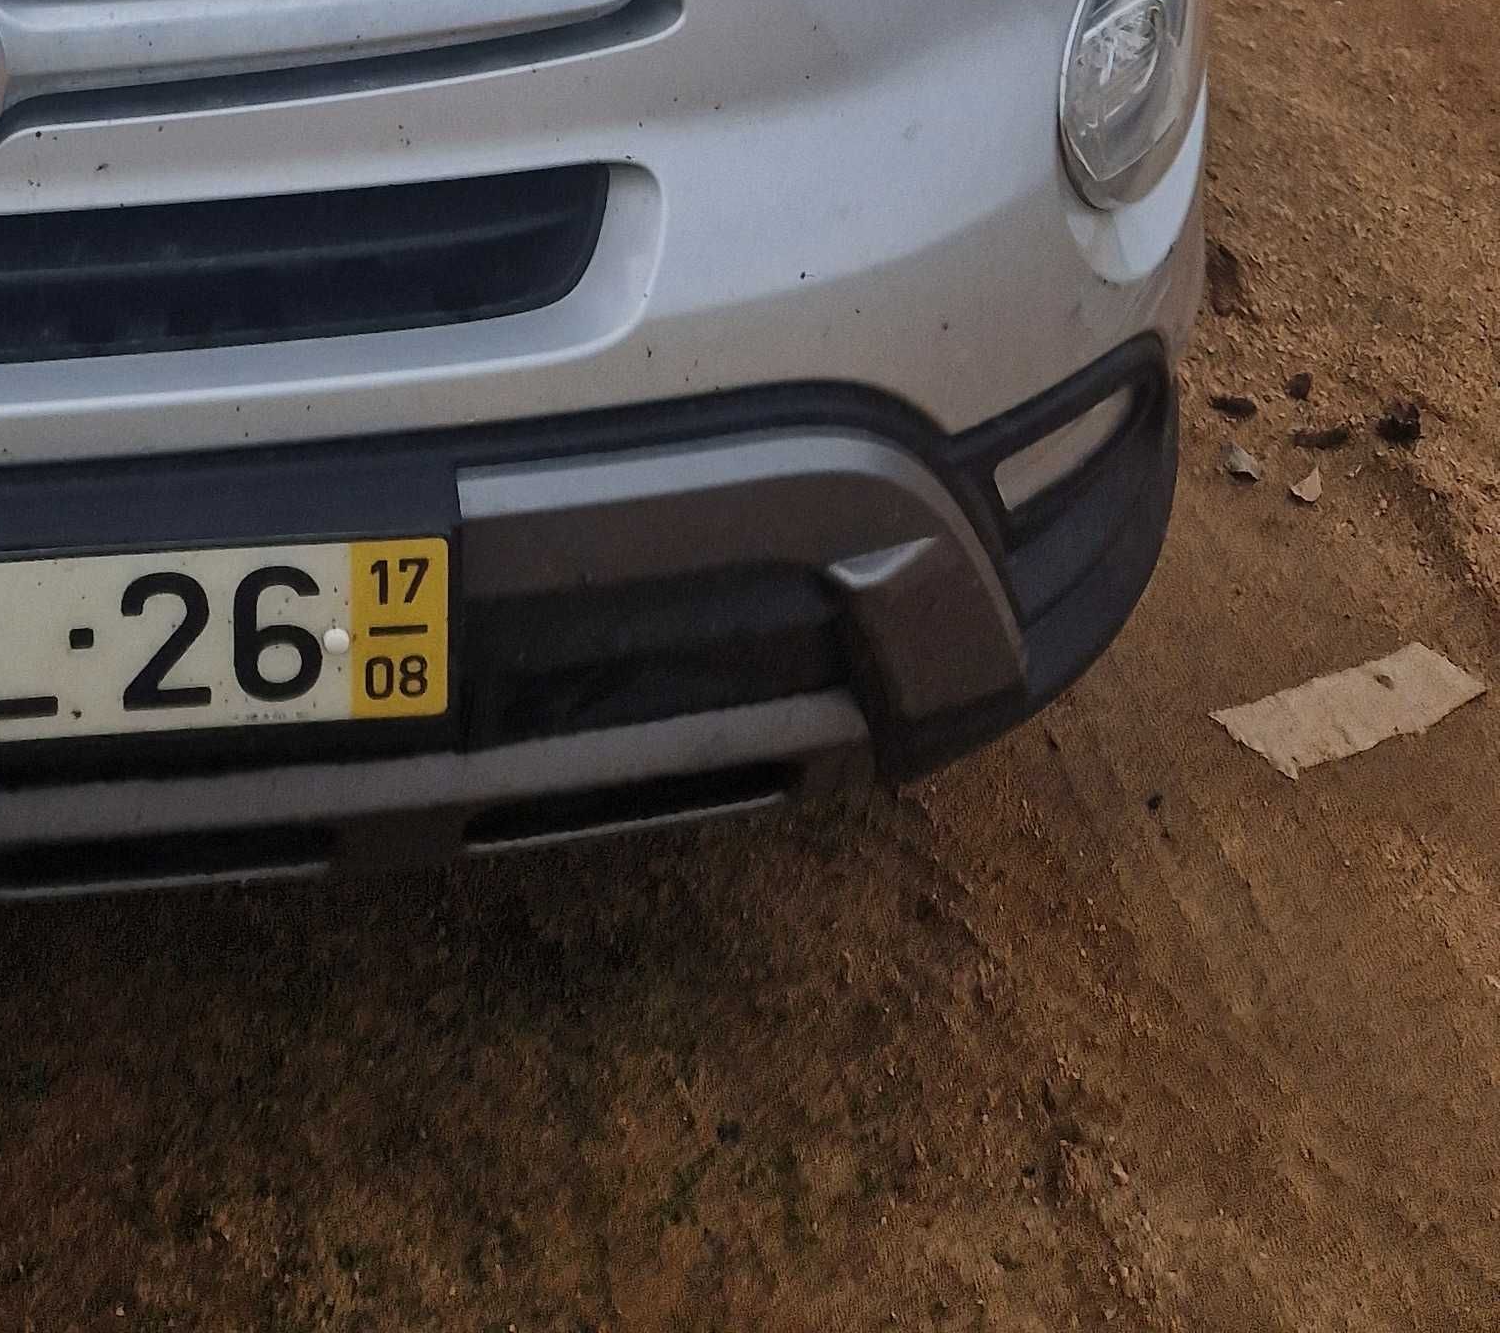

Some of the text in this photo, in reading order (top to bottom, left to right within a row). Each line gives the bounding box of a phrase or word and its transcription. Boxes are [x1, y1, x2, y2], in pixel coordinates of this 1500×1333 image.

[369, 557, 430, 606] 17
[120, 564, 324, 712] 26
[364, 653, 429, 701] 08
